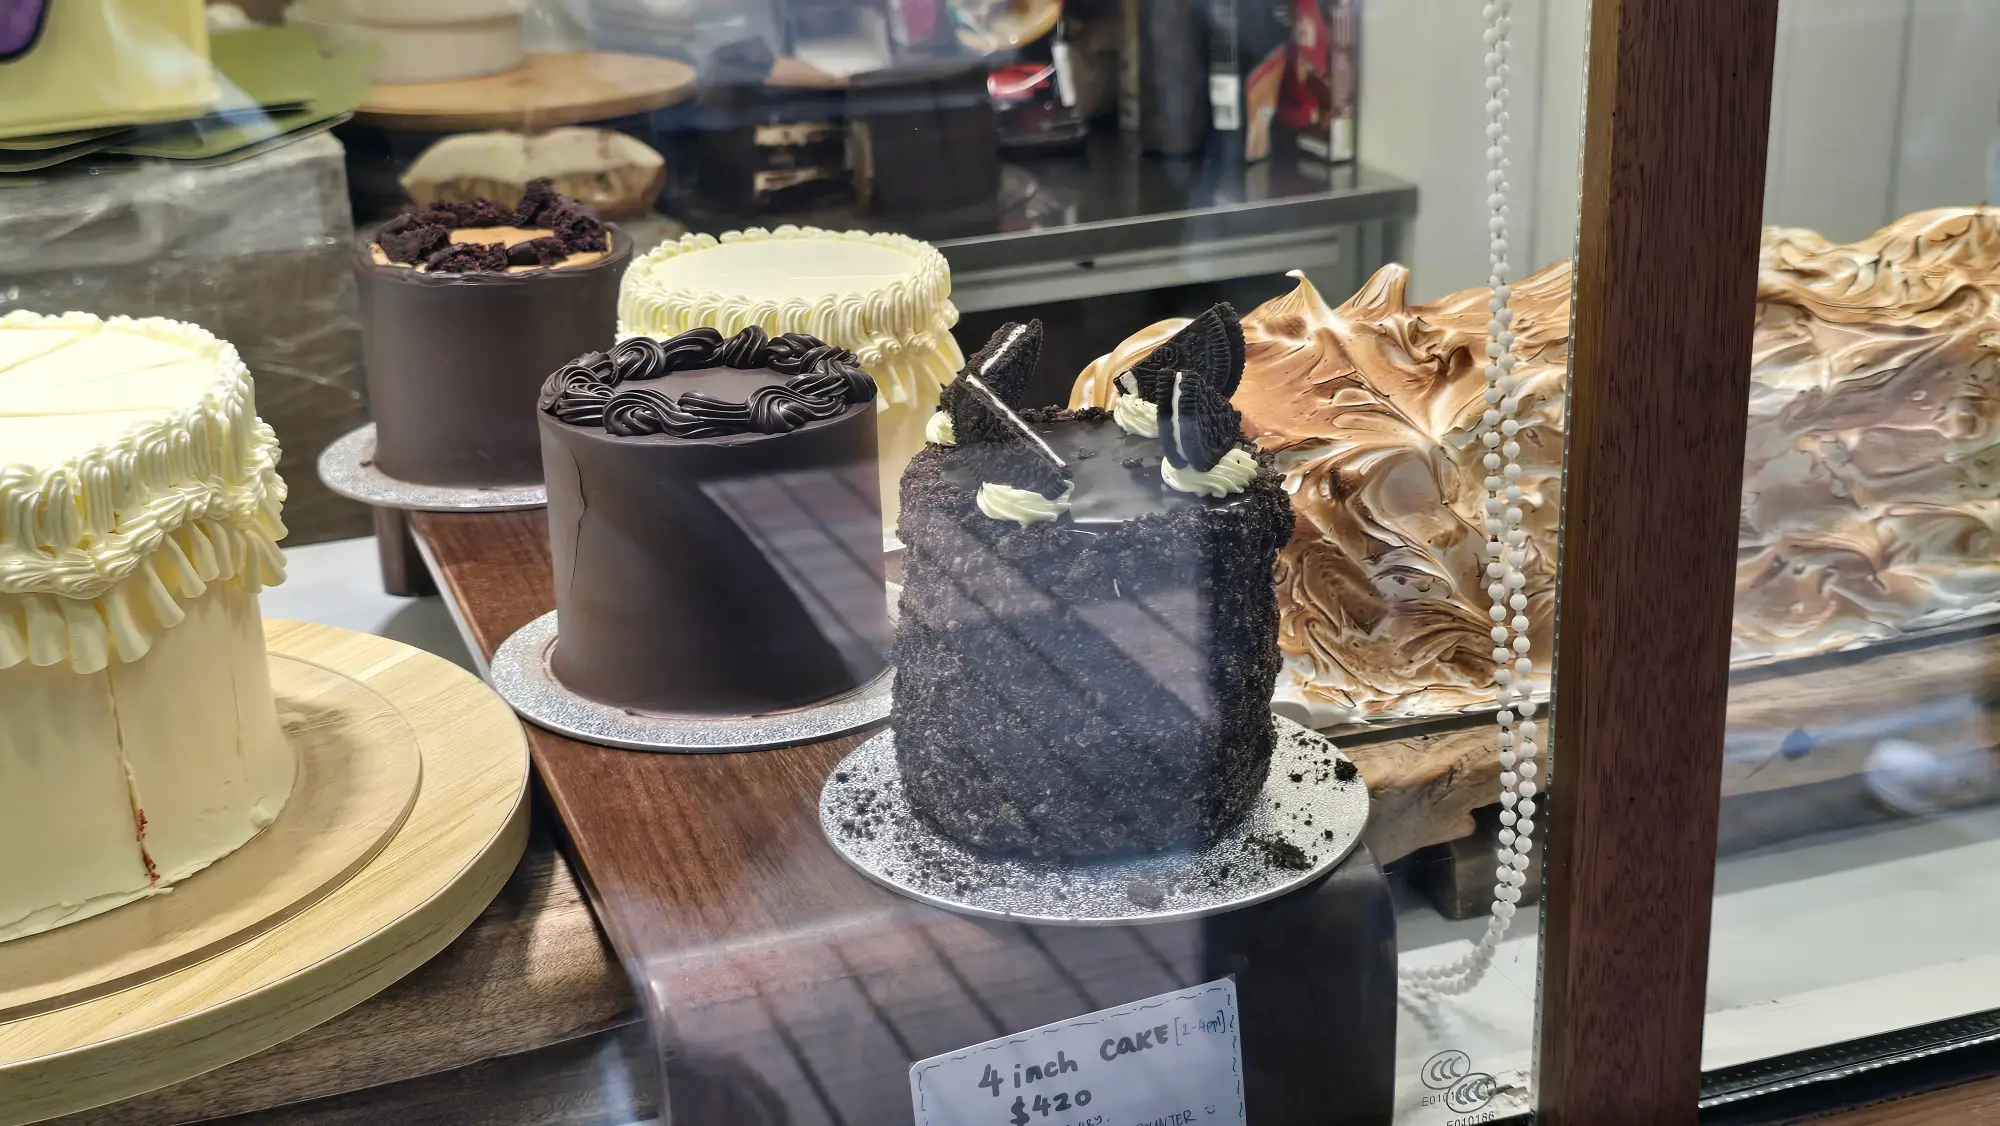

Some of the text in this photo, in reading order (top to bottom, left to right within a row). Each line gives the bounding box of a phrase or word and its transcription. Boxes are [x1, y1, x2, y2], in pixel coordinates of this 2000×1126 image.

[978, 1063, 1004, 1097] 4
[1013, 1050, 1079, 1089] inch
[1009, 1089, 1092, 1126] $420
